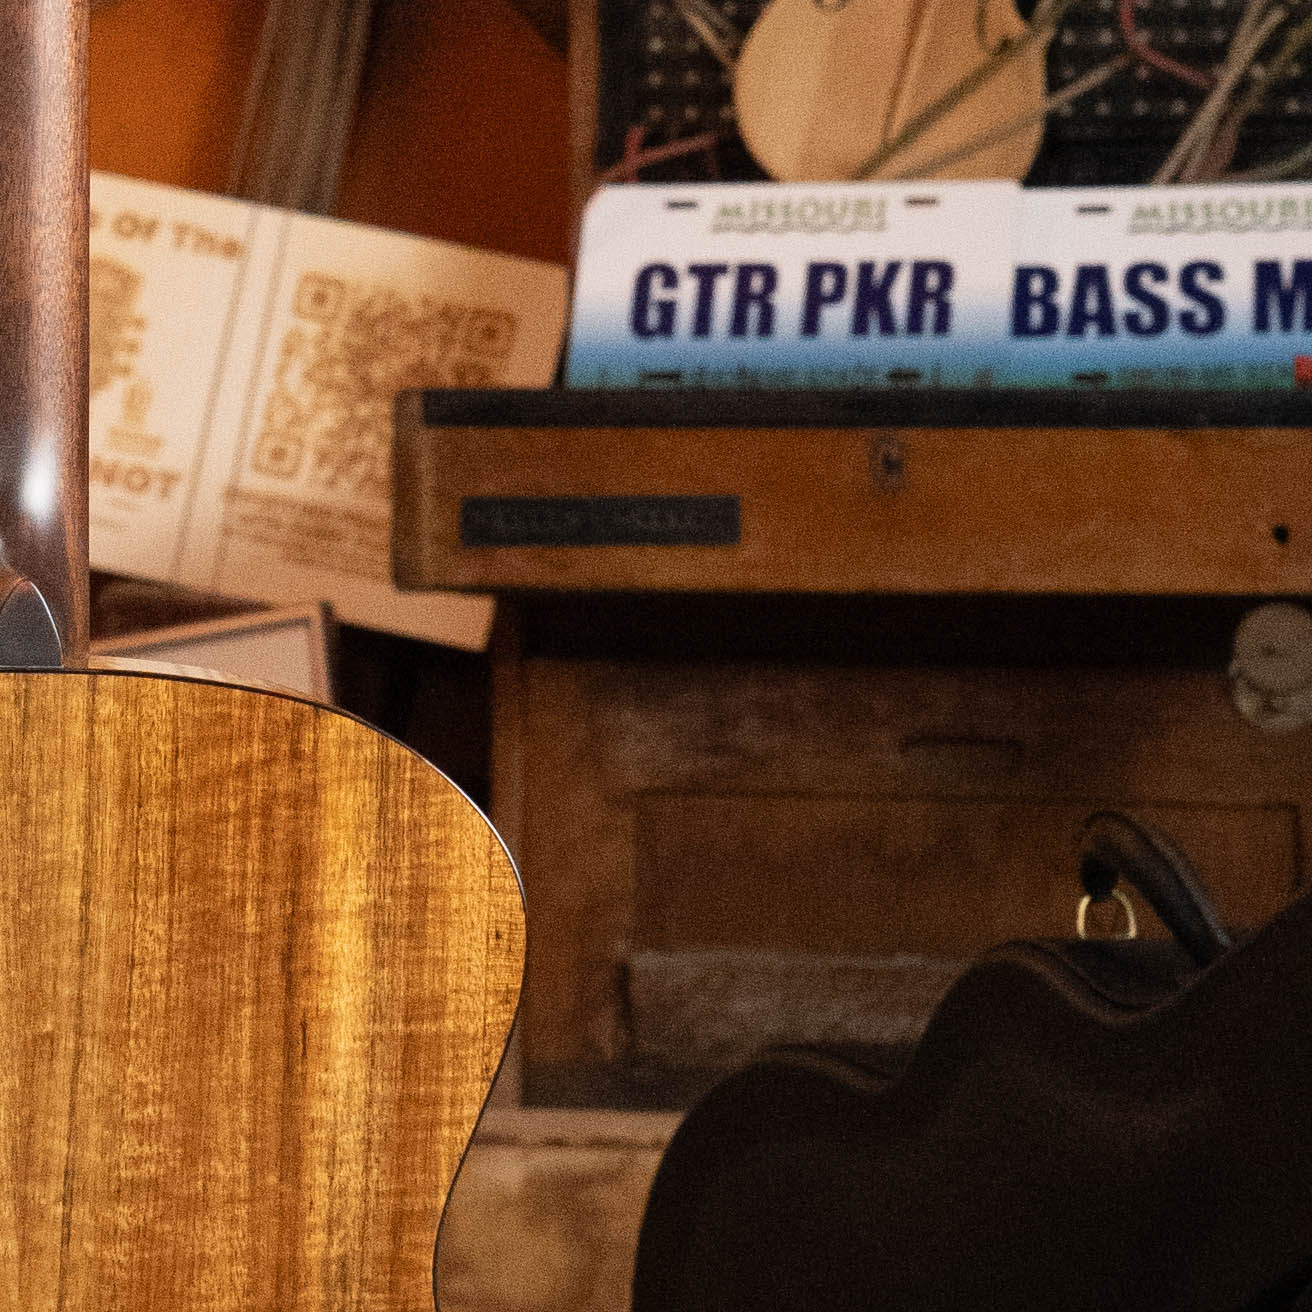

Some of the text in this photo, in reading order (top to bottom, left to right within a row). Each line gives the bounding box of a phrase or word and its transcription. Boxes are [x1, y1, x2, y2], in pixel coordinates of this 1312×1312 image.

[713, 197, 889, 227] MISSOURI
[628, 259, 956, 340] GTR PKR
[1009, 259, 1228, 339] BASS
